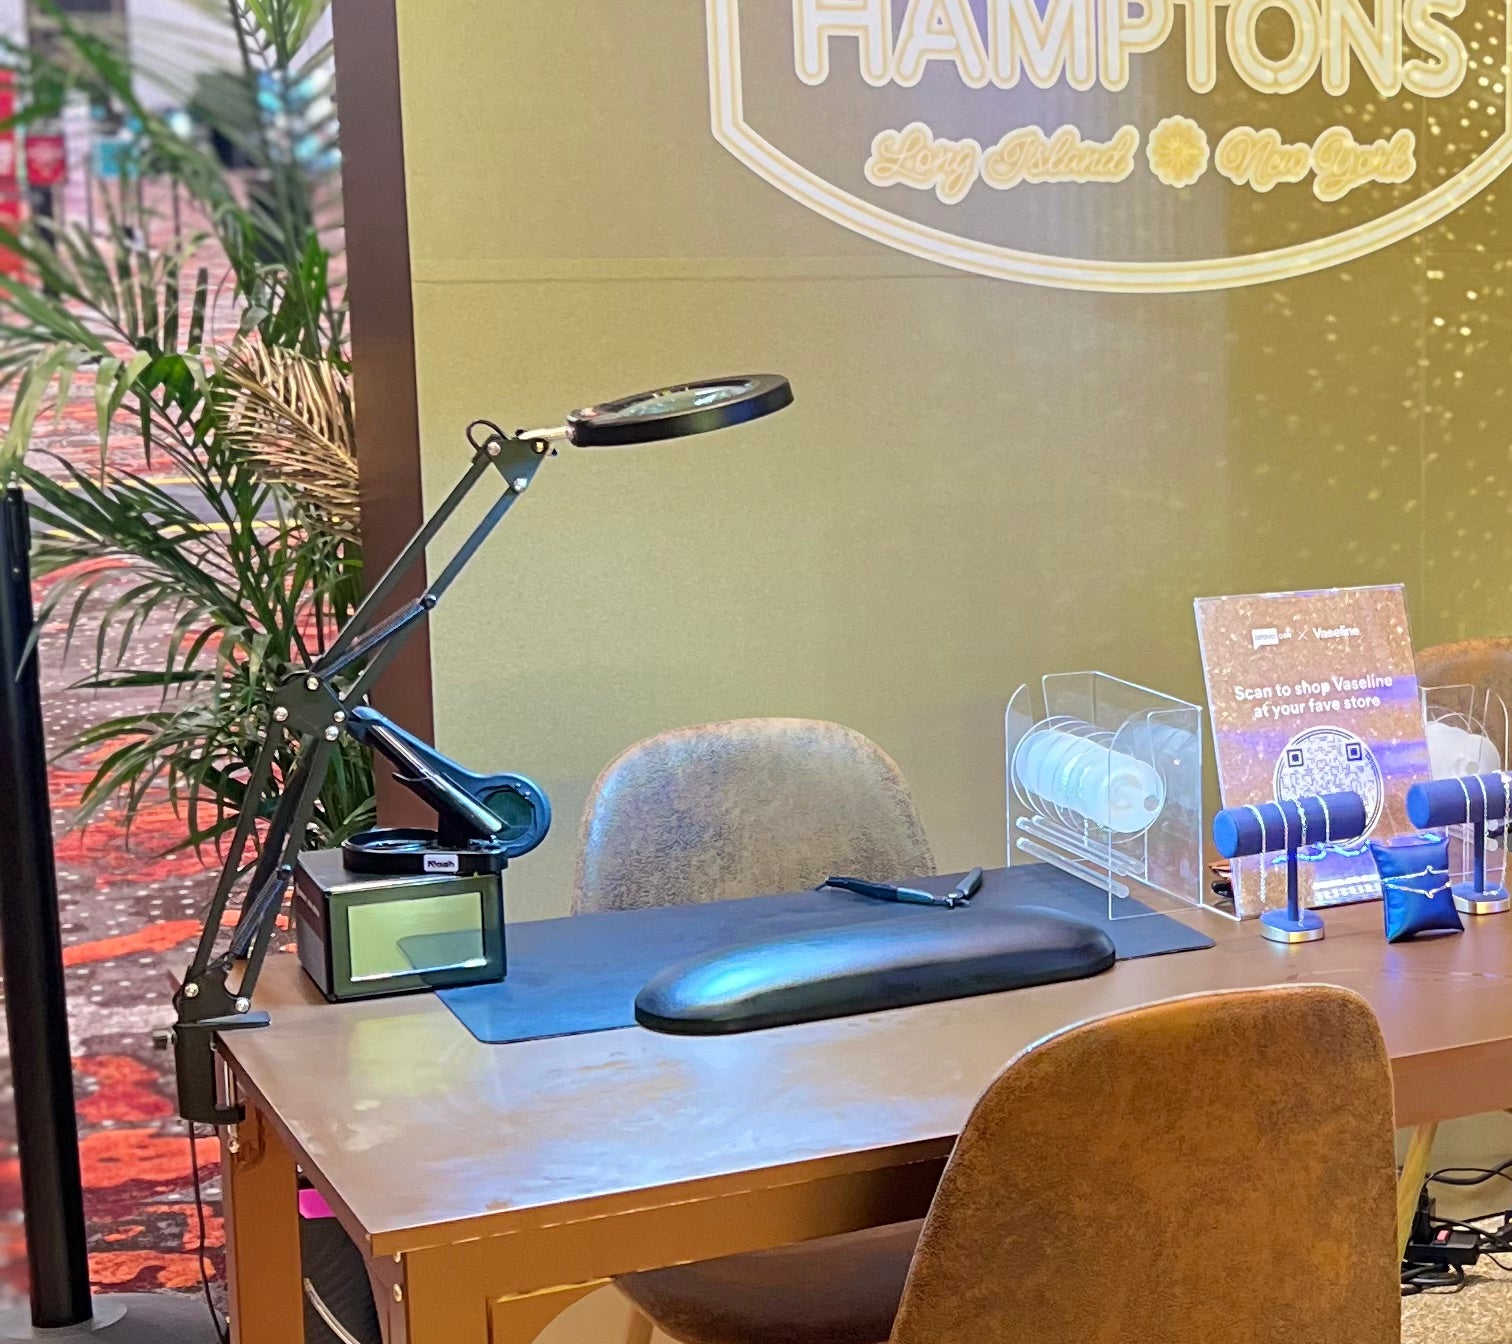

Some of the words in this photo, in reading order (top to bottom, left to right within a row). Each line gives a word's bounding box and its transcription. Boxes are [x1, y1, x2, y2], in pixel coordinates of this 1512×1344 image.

[865, 123, 981, 203] Long
[981, 125, 1139, 189] Island
[1215, 126, 1311, 192] New
[1310, 126, 1415, 202] York
[1234, 685, 1272, 701] Scan
[1275, 684, 1291, 697] to
[1295, 680, 1331, 697] shop
[1332, 674, 1393, 692] Vaseline
[1254, 703, 1269, 719] at
[1272, 703, 1305, 720] your
[1309, 698, 1340, 713] fave
[1344, 695, 1382, 710] store
